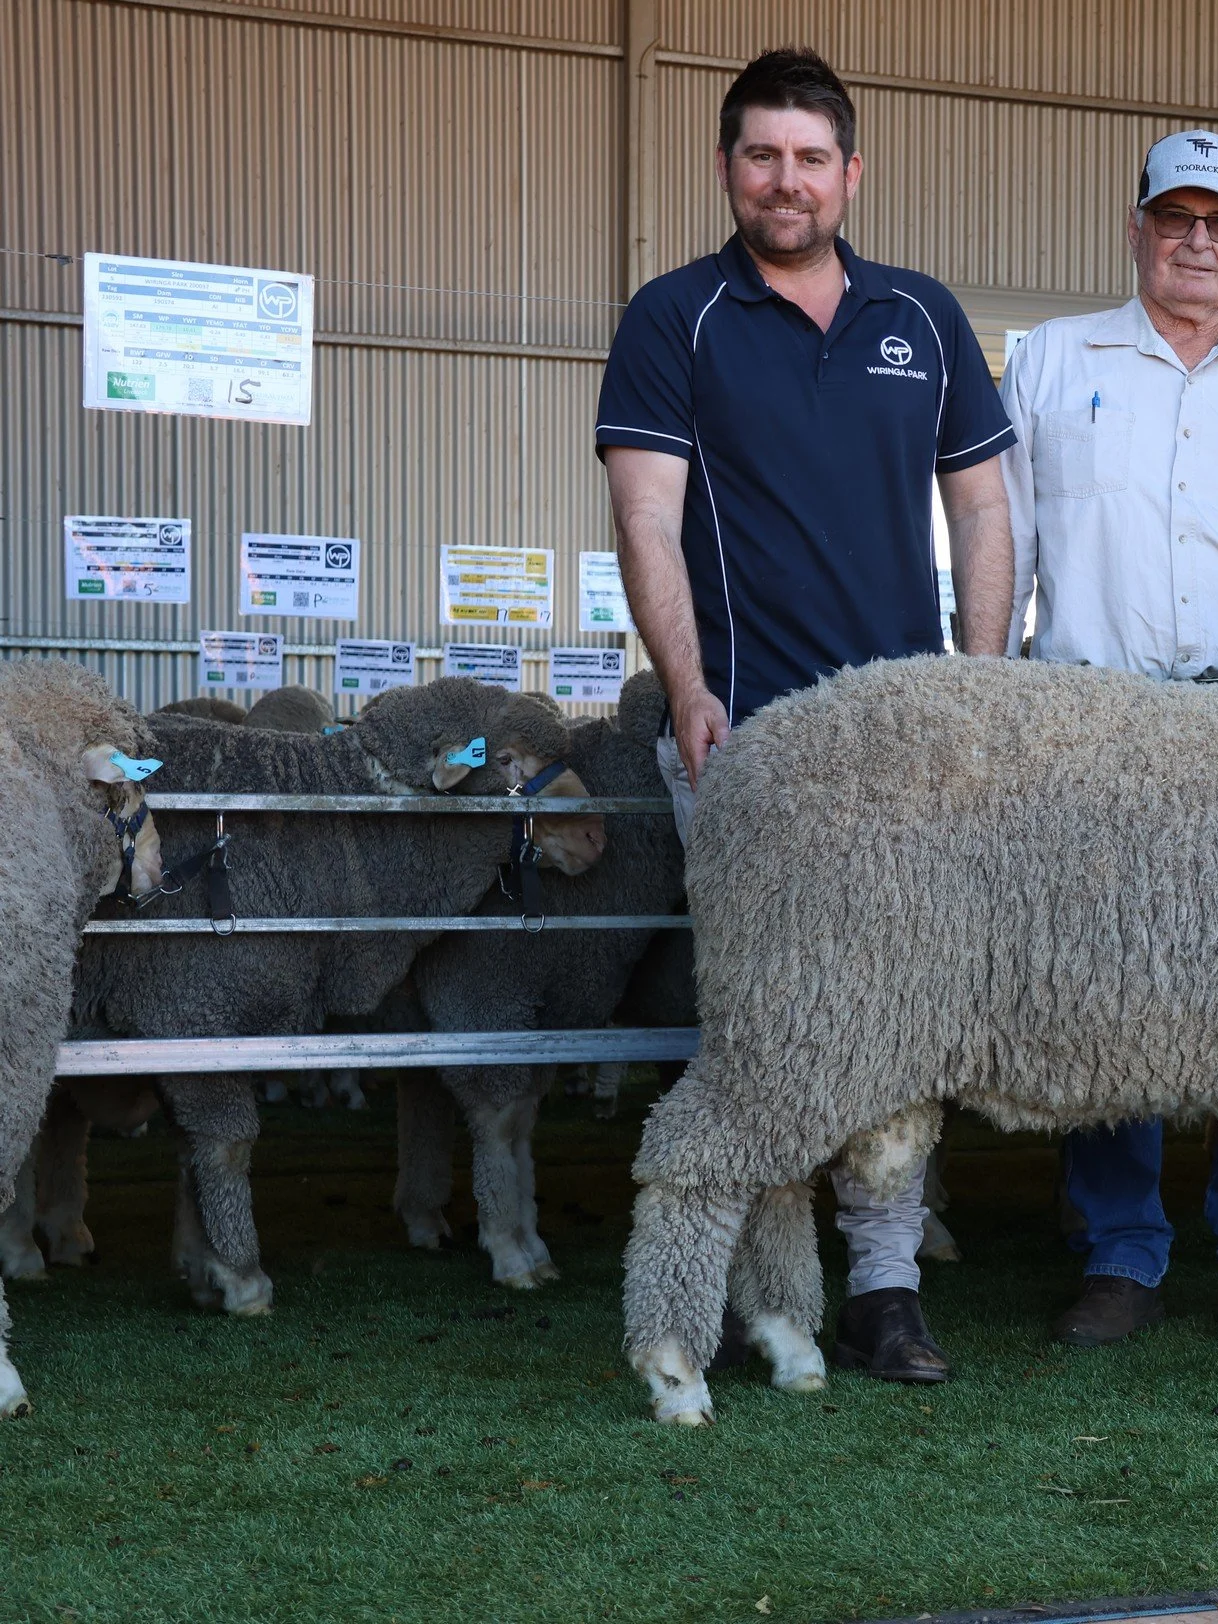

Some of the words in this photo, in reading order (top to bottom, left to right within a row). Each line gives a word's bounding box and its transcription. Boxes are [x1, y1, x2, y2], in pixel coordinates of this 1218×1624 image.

[144, 279, 171, 287] WIRINGA
[171, 271, 184, 279] Sire
[233, 277, 248, 285] Horn
[107, 285, 118, 293] Tag
[866, 366, 907, 377] WIRINGA
[907, 370, 928, 381] PARK
[113, 377, 150, 388] Nutrien
[144, 583, 154, 596] 5
[137, 766, 152, 774] 5
